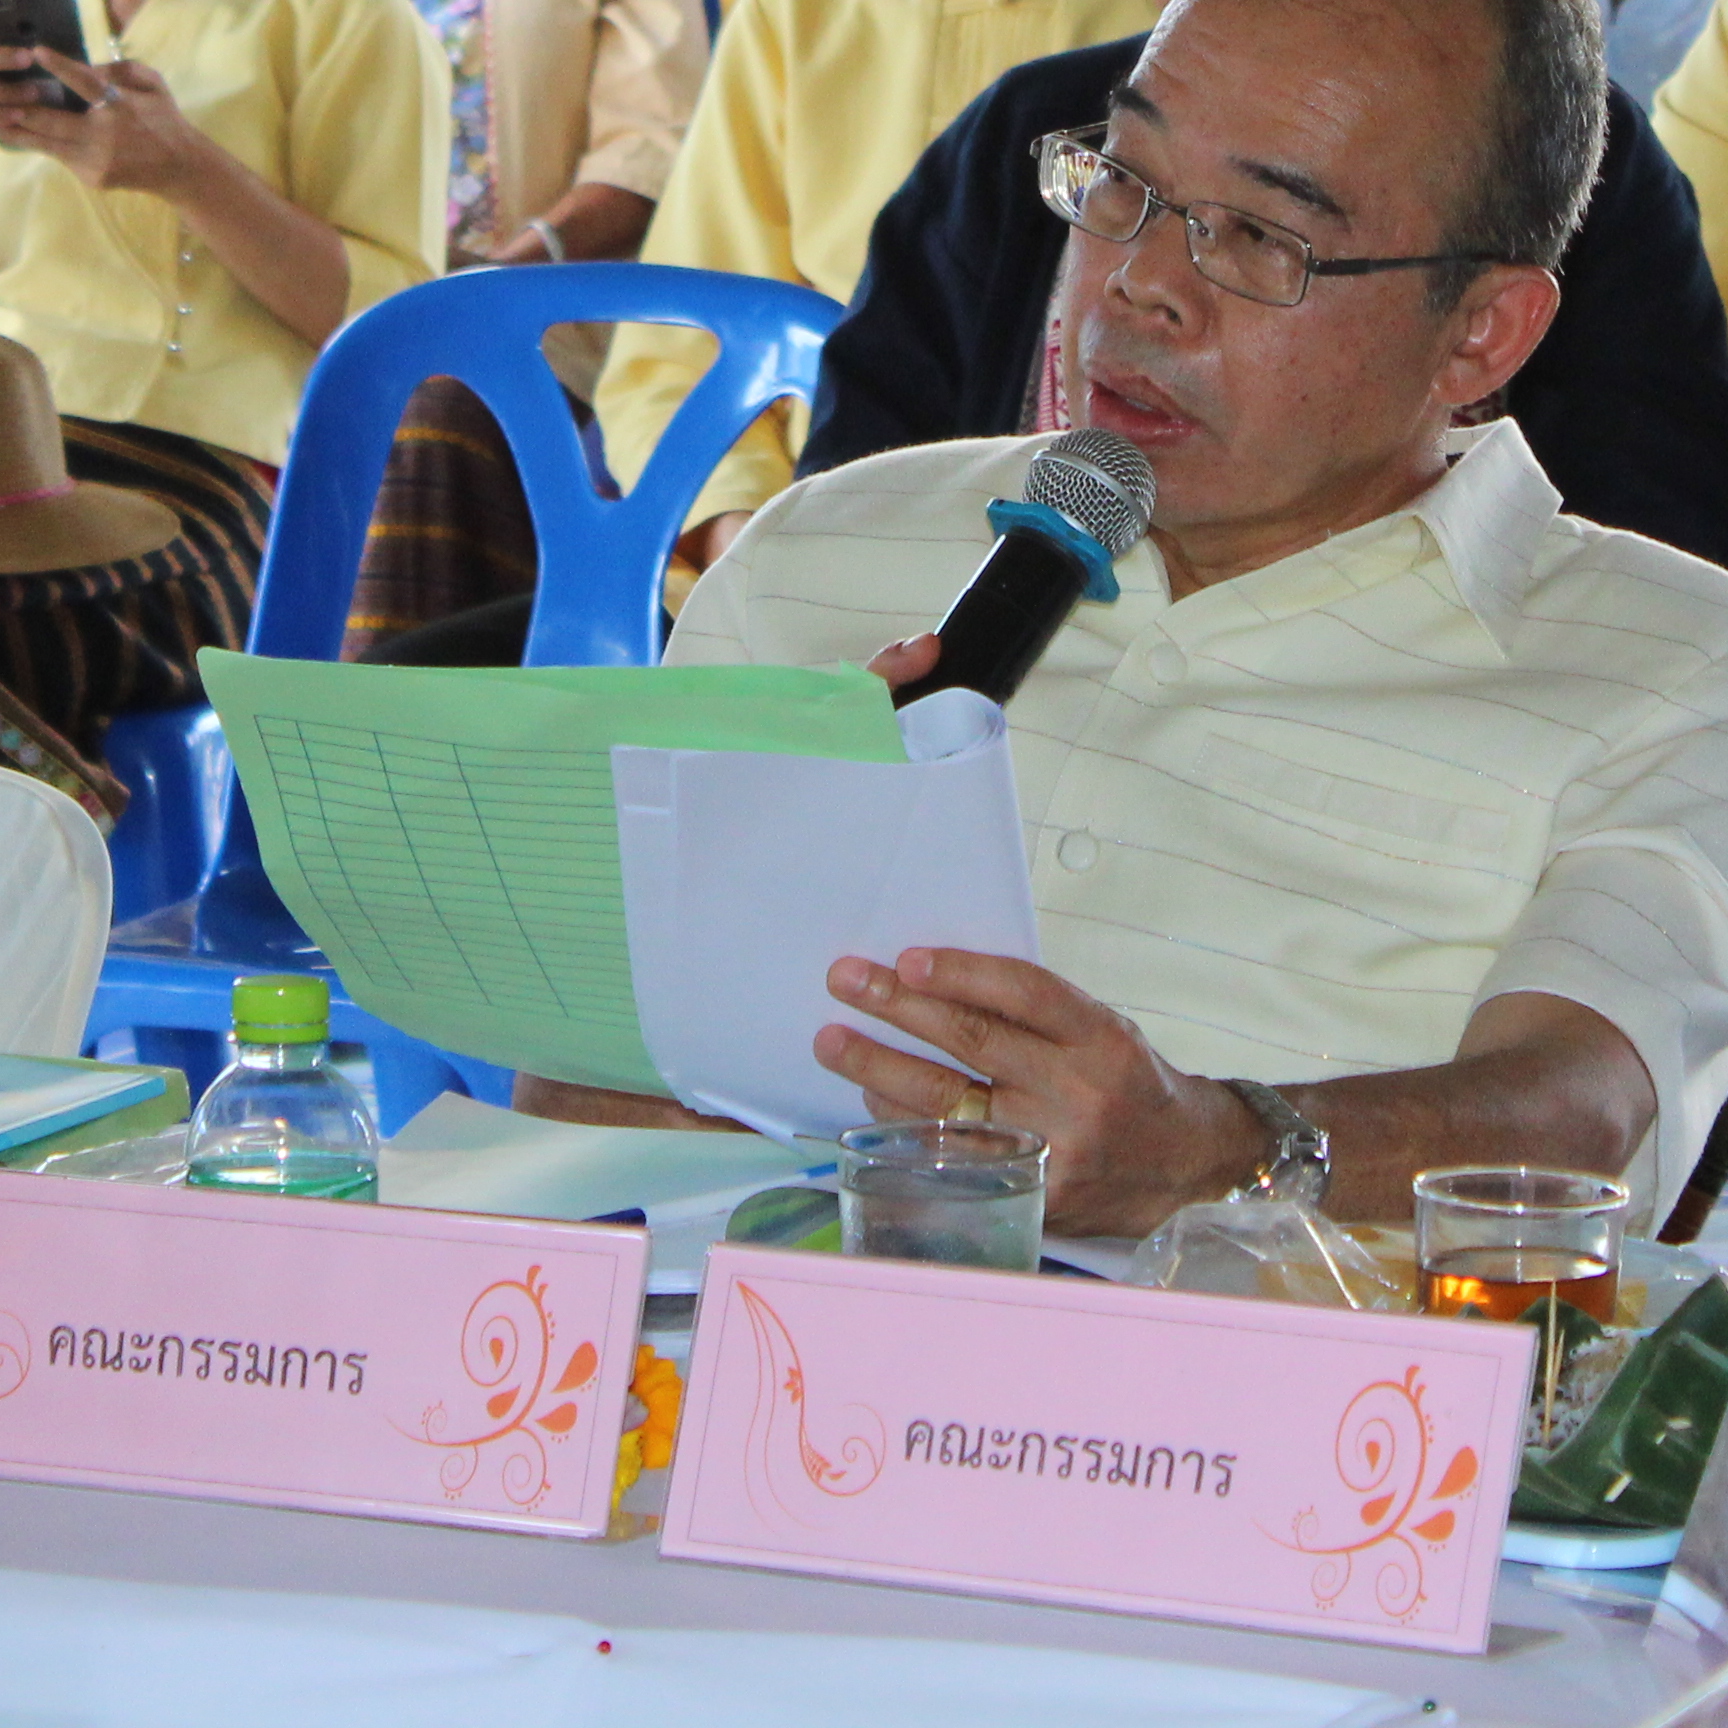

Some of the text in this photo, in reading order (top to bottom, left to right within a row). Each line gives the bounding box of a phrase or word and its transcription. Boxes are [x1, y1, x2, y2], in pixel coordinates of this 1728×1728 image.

[48, 1316, 369, 1396] คณะกรรมการ
[902, 1412, 1239, 1500] คณะกรรมการ
